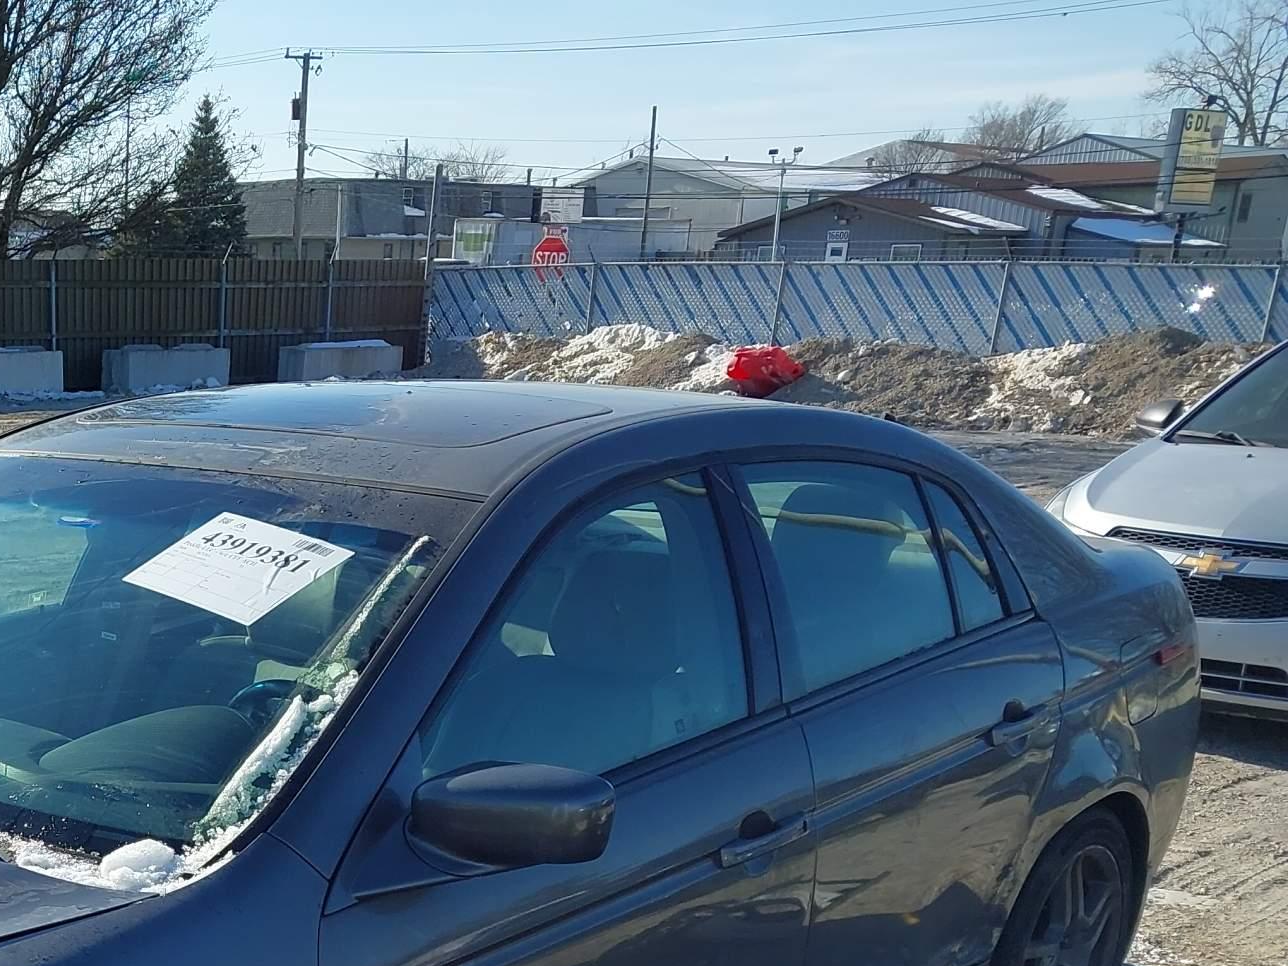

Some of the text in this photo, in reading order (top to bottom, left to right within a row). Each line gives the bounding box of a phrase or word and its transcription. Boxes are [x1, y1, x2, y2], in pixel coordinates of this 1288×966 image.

[1184, 113, 1211, 133] GDL
[535, 251, 567, 266] STOP
[201, 530, 312, 574] 43919381
